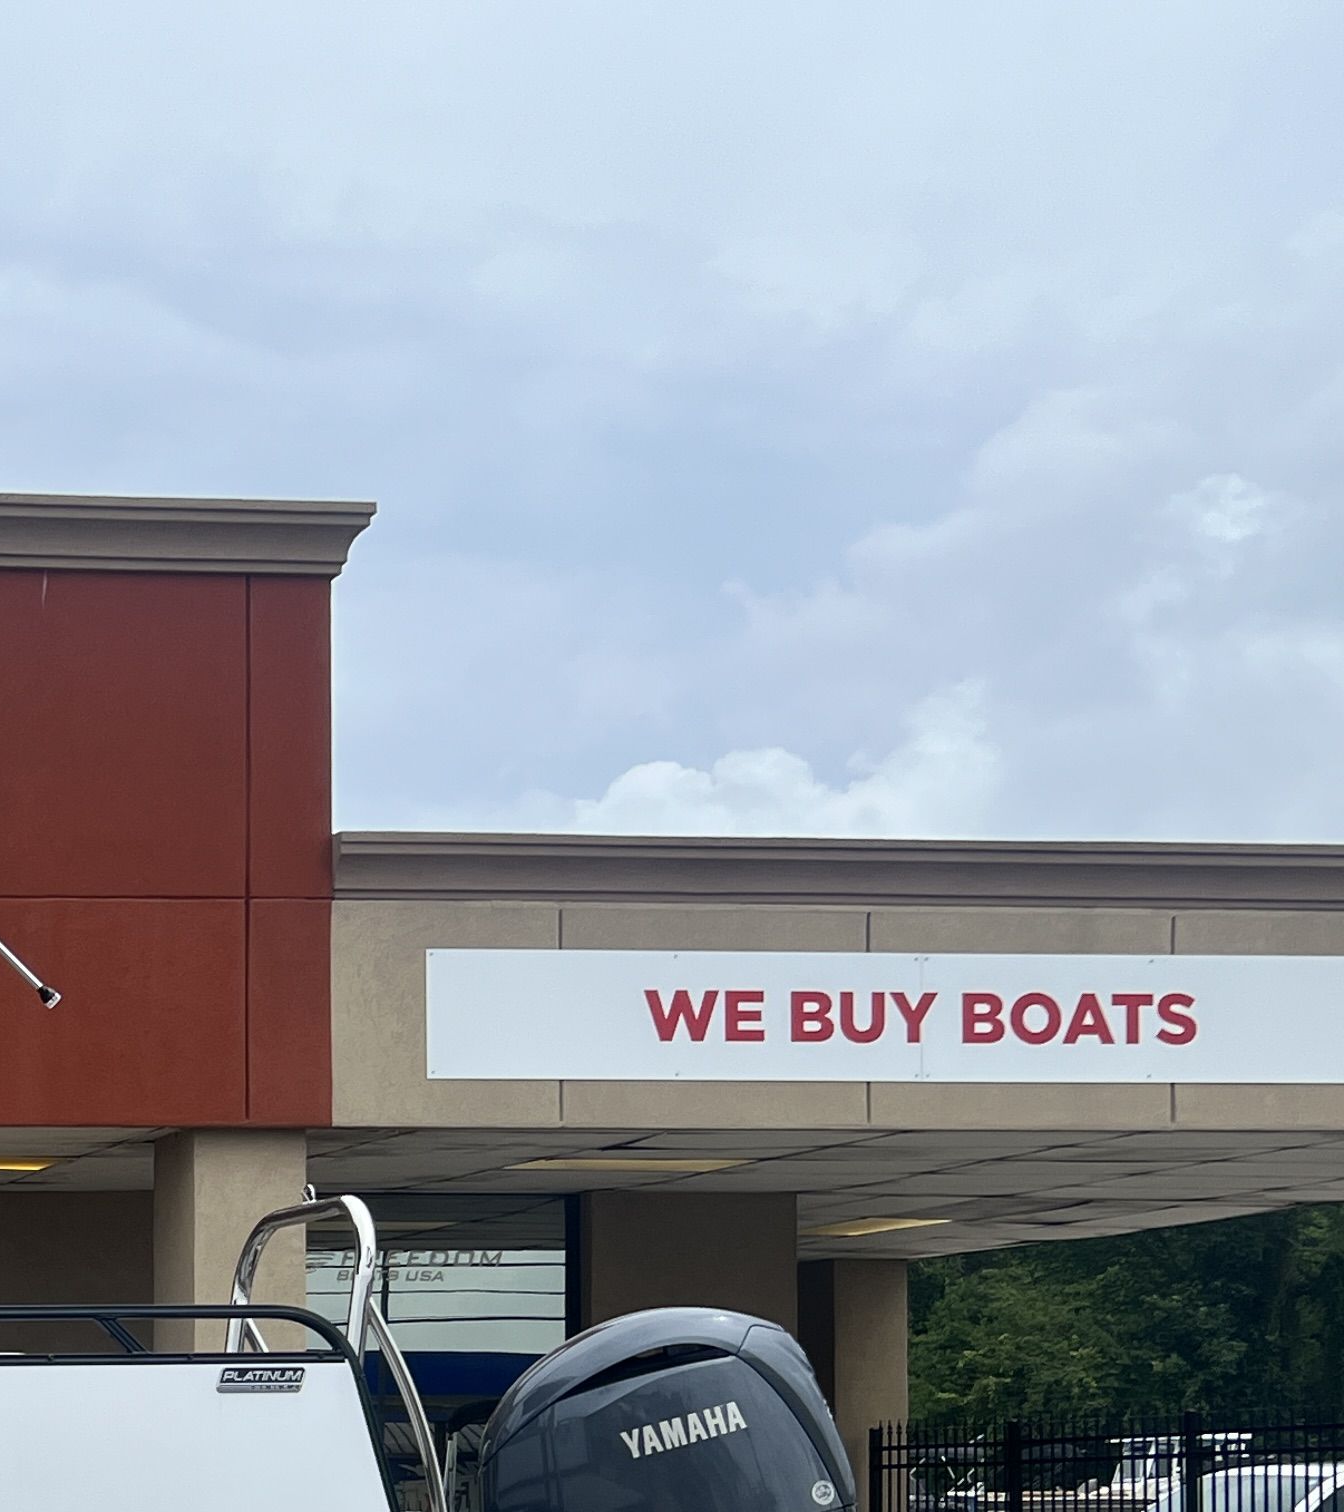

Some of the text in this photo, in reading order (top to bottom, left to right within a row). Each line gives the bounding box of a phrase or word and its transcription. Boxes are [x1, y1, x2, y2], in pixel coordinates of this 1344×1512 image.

[644, 989, 1198, 1045] WE BUY BOATS
[341, 1249, 503, 1267] FEEDOM
[405, 1270, 444, 1282] USA
[222, 1370, 303, 1382] PLATINUM
[619, 1400, 748, 1460] YAMAHA
